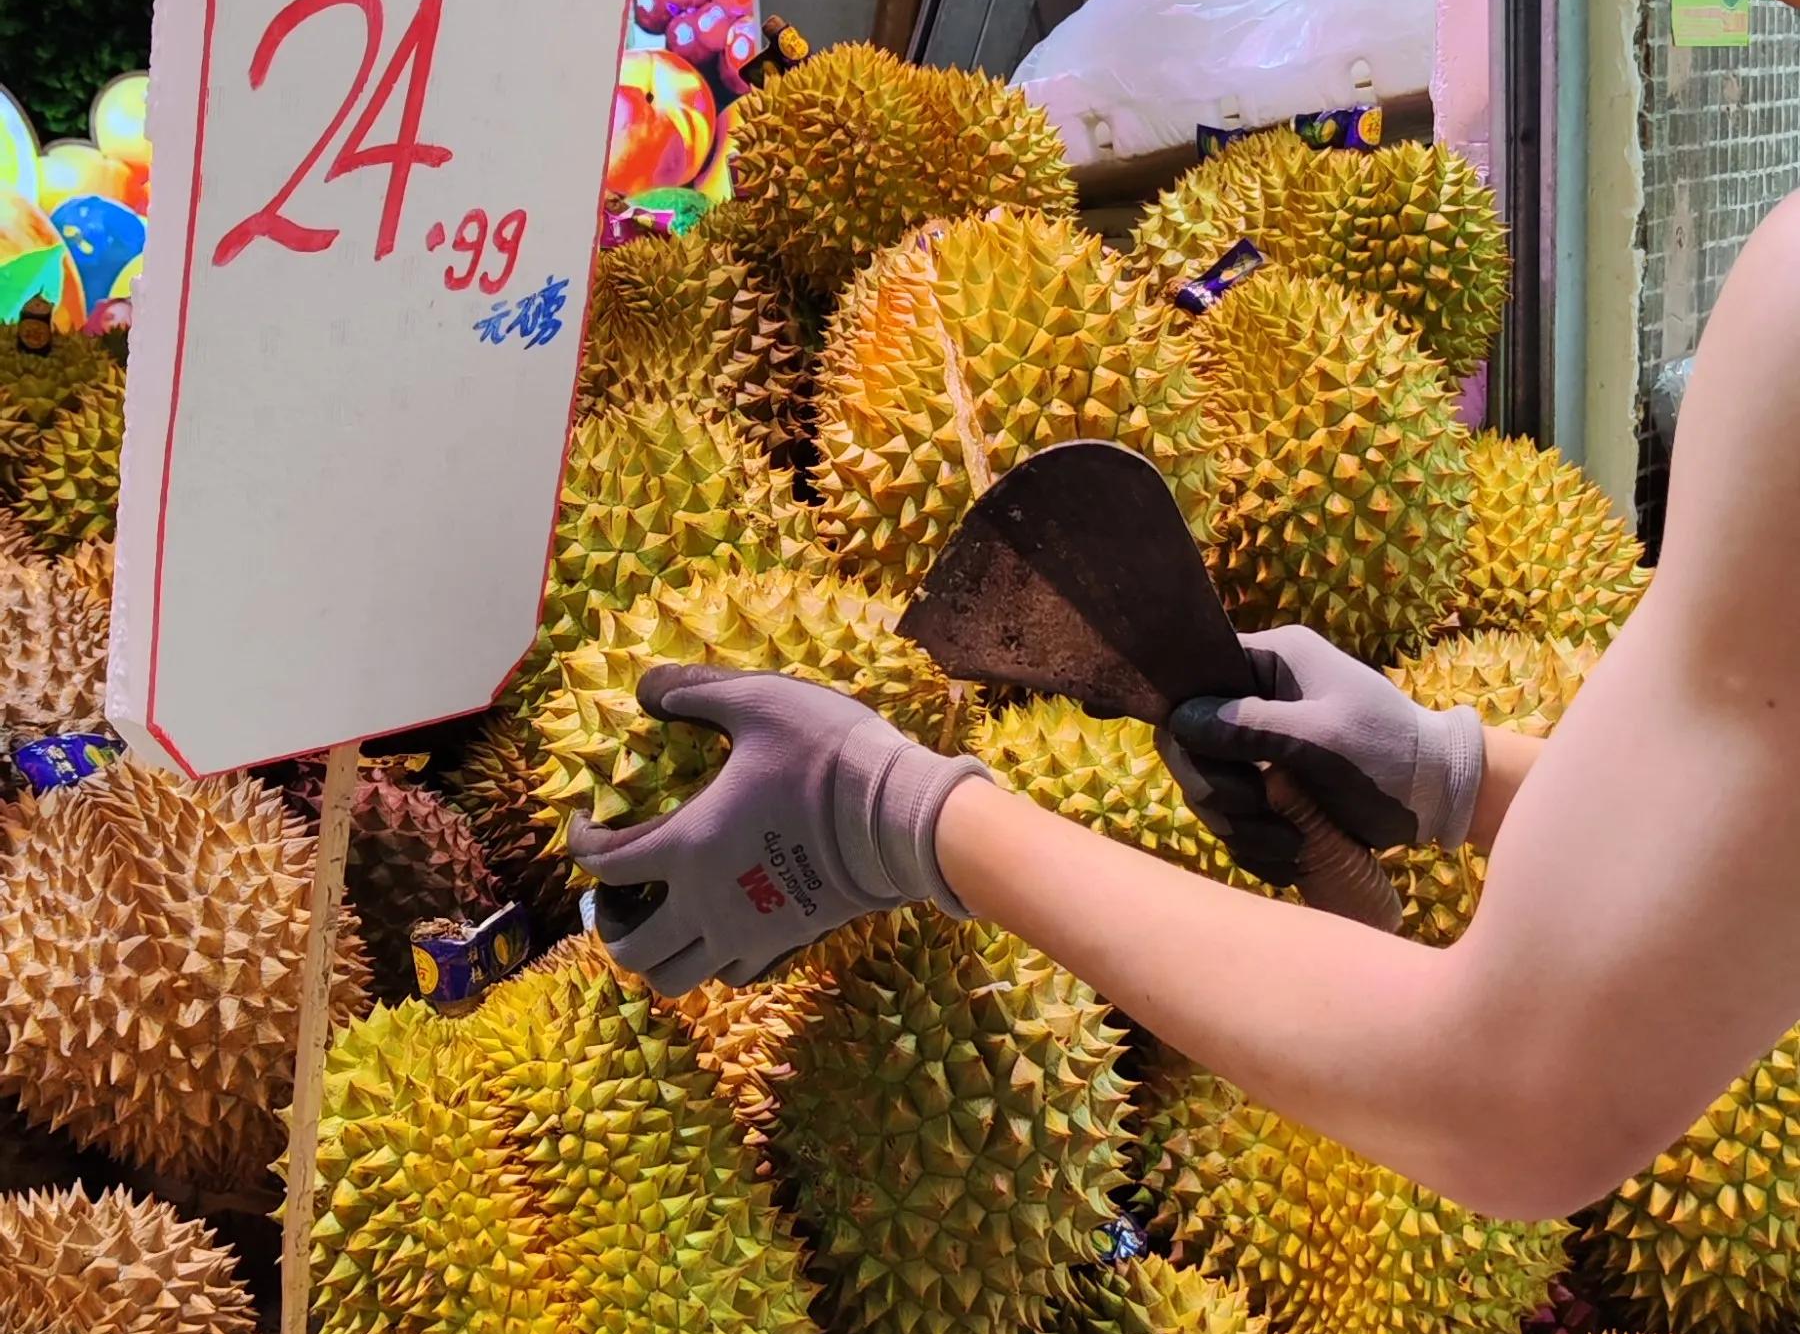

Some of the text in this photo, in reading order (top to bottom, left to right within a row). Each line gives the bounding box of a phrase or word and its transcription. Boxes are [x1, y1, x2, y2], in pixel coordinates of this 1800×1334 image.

[736, 862, 786, 914] 3M
[764, 831, 818, 917] Comfort Grip
[791, 843, 823, 891] Gloves
